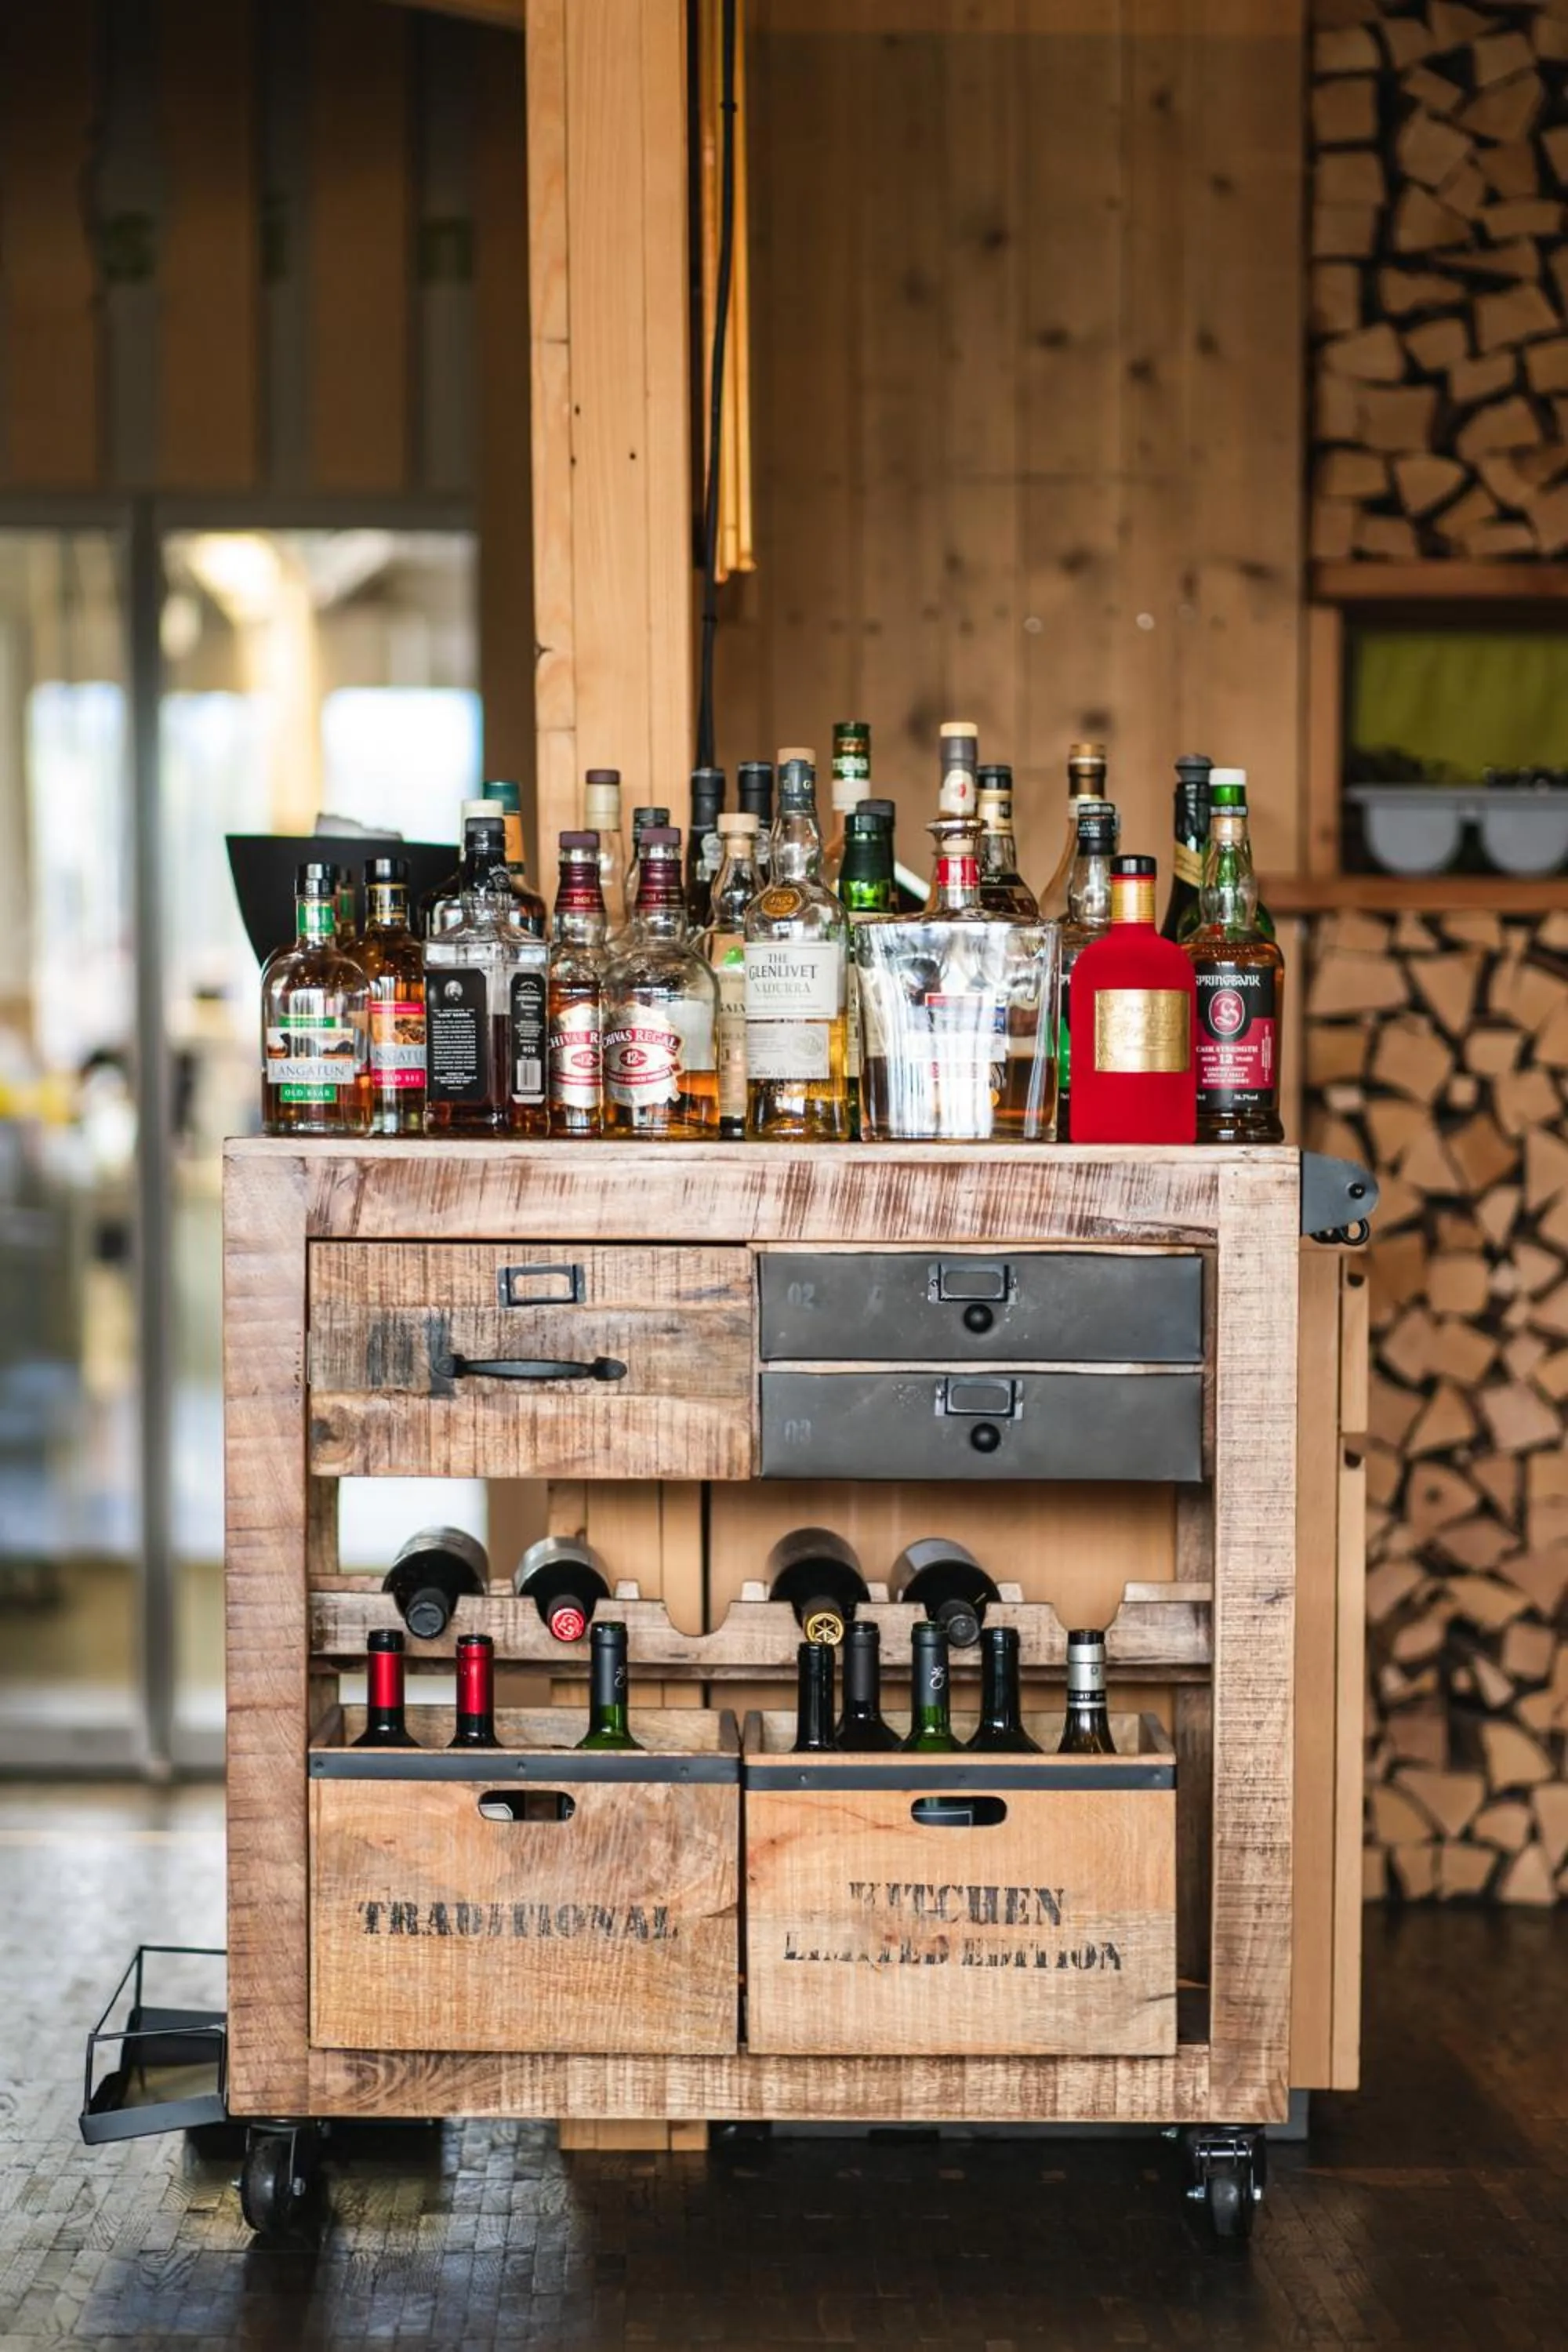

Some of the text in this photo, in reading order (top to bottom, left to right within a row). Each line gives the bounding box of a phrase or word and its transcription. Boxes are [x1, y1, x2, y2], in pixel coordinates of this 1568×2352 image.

[768, 953, 787, 964] THE
[749, 964, 818, 980] GLENLIVET
[754, 982, 812, 994] NADURRA
[1195, 975, 1261, 988] SPRINGBANK
[550, 1033, 587, 1048] HIVAS
[604, 1029, 634, 1049] CHIVAS
[635, 1029, 677, 1049] REGAL
[626, 1051, 639, 1064] 12
[1219, 1053, 1233, 1065] 12
[270, 1062, 344, 1076] LANGATUN
[284, 1089, 304, 1098] OLD
[357, 1900, 680, 1940] TRADITIONAL
